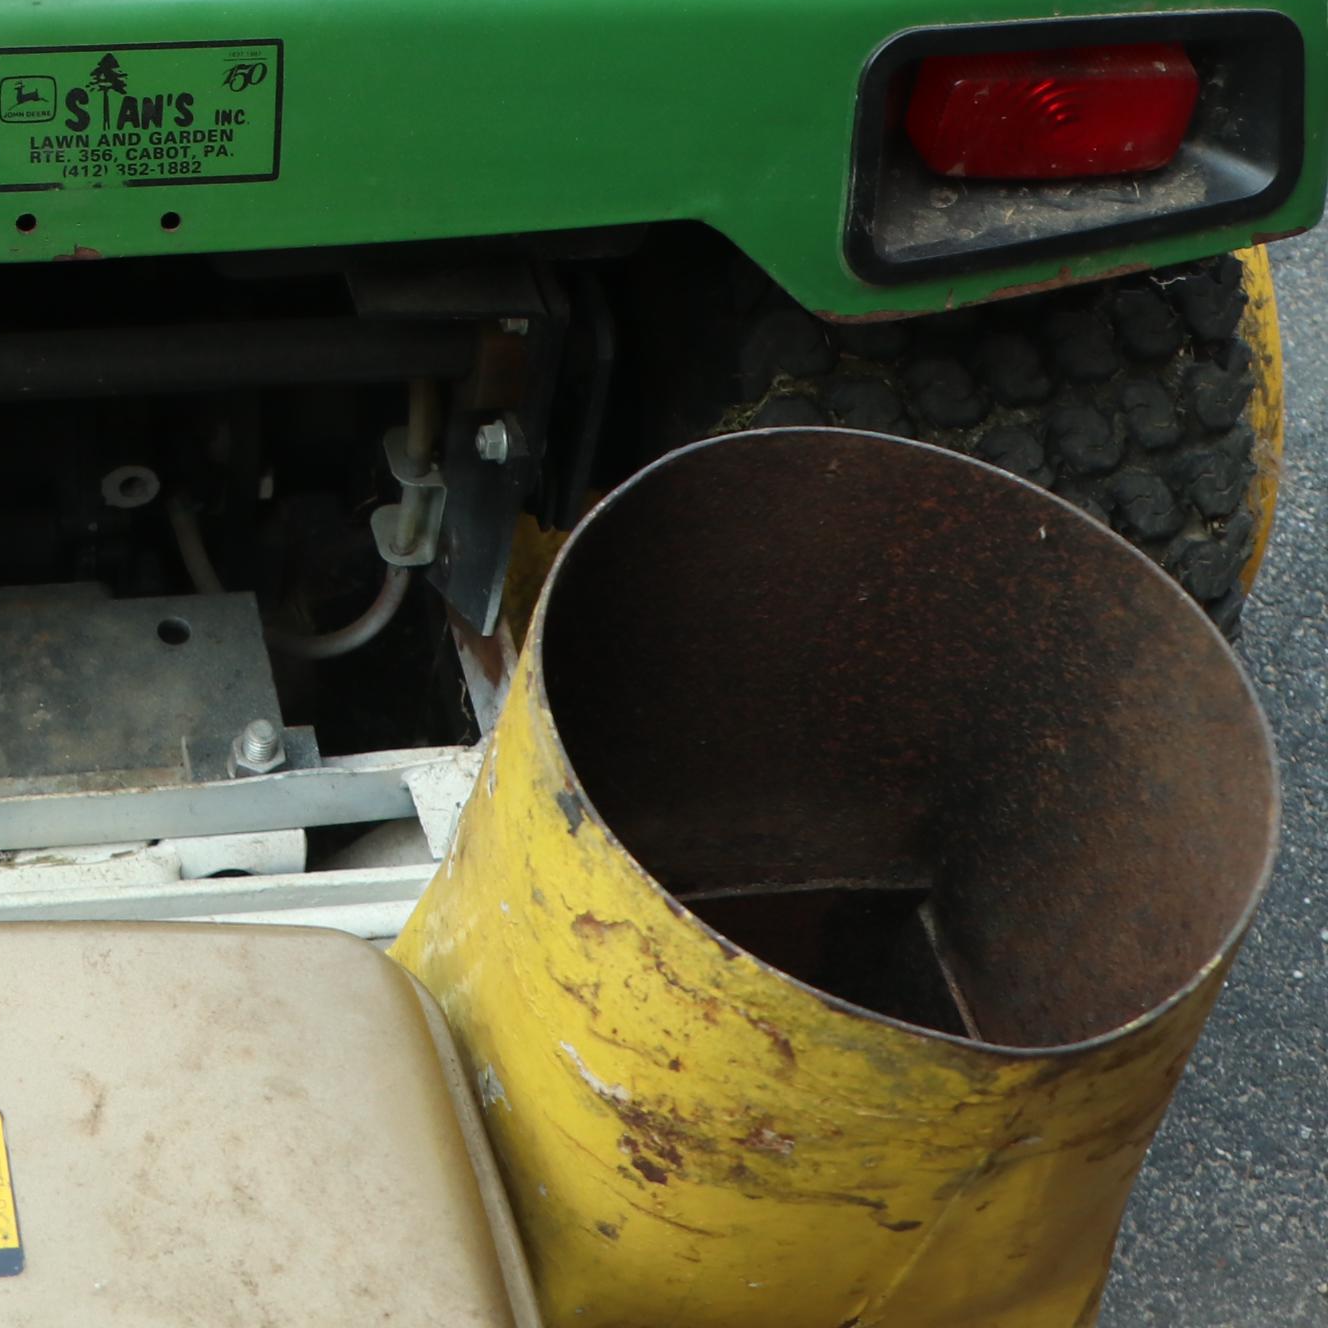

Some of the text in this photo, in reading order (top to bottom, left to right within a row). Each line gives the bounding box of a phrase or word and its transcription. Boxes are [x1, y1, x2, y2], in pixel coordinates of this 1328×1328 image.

[222, 62, 268, 93] 150
[215, 108, 250, 126] INC.
[29, 128, 234, 151] LAWN AND GARDEN
[29, 143, 234, 164] RTE. 356, CABOT, PA.
[62, 160, 202, 179] (412) 352-1882
